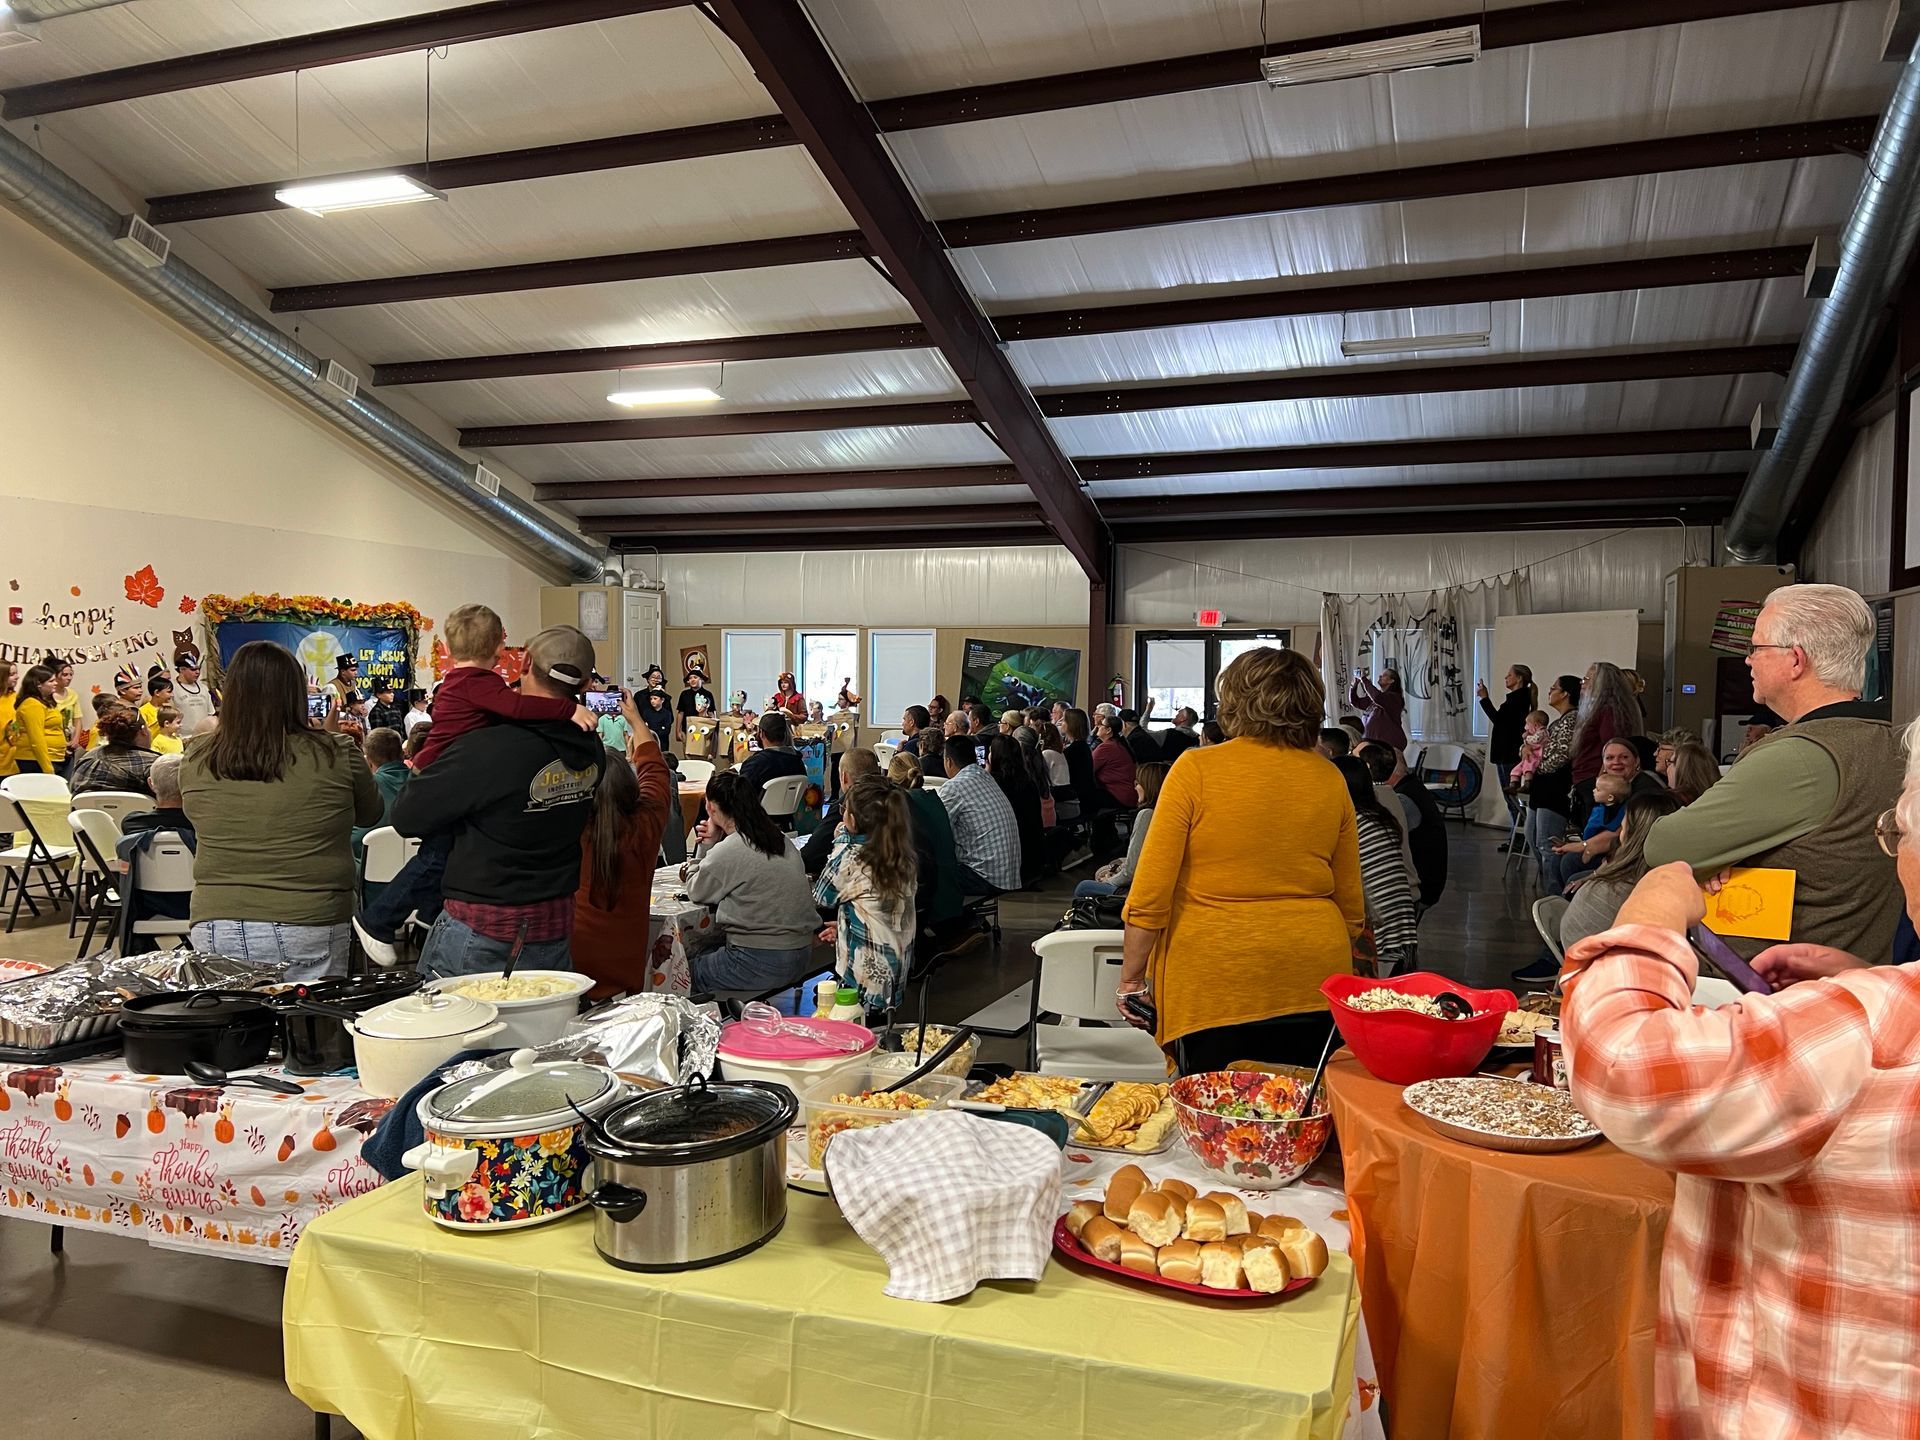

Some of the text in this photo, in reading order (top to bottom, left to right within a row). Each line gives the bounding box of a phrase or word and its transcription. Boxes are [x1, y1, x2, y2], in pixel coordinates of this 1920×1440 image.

[33, 602, 115, 638] happy
[1200, 610, 1219, 625] EXIT
[1727, 621, 1754, 629] PATIEN
[0, 629, 158, 665] THANKSGIVING
[359, 649, 406, 662] LET JESUS
[367, 663, 394, 675] LIGHT
[355, 677, 372, 689] YO
[23, 1115, 45, 1131] Happy
[0, 1119, 61, 1166] Thanks
[178, 1137, 204, 1154] Happy
[7, 1161, 59, 1192] giving
[152, 1142, 219, 1189] Thanks
[327, 1158, 385, 1199] Than
[160, 1187, 223, 1215] giving
